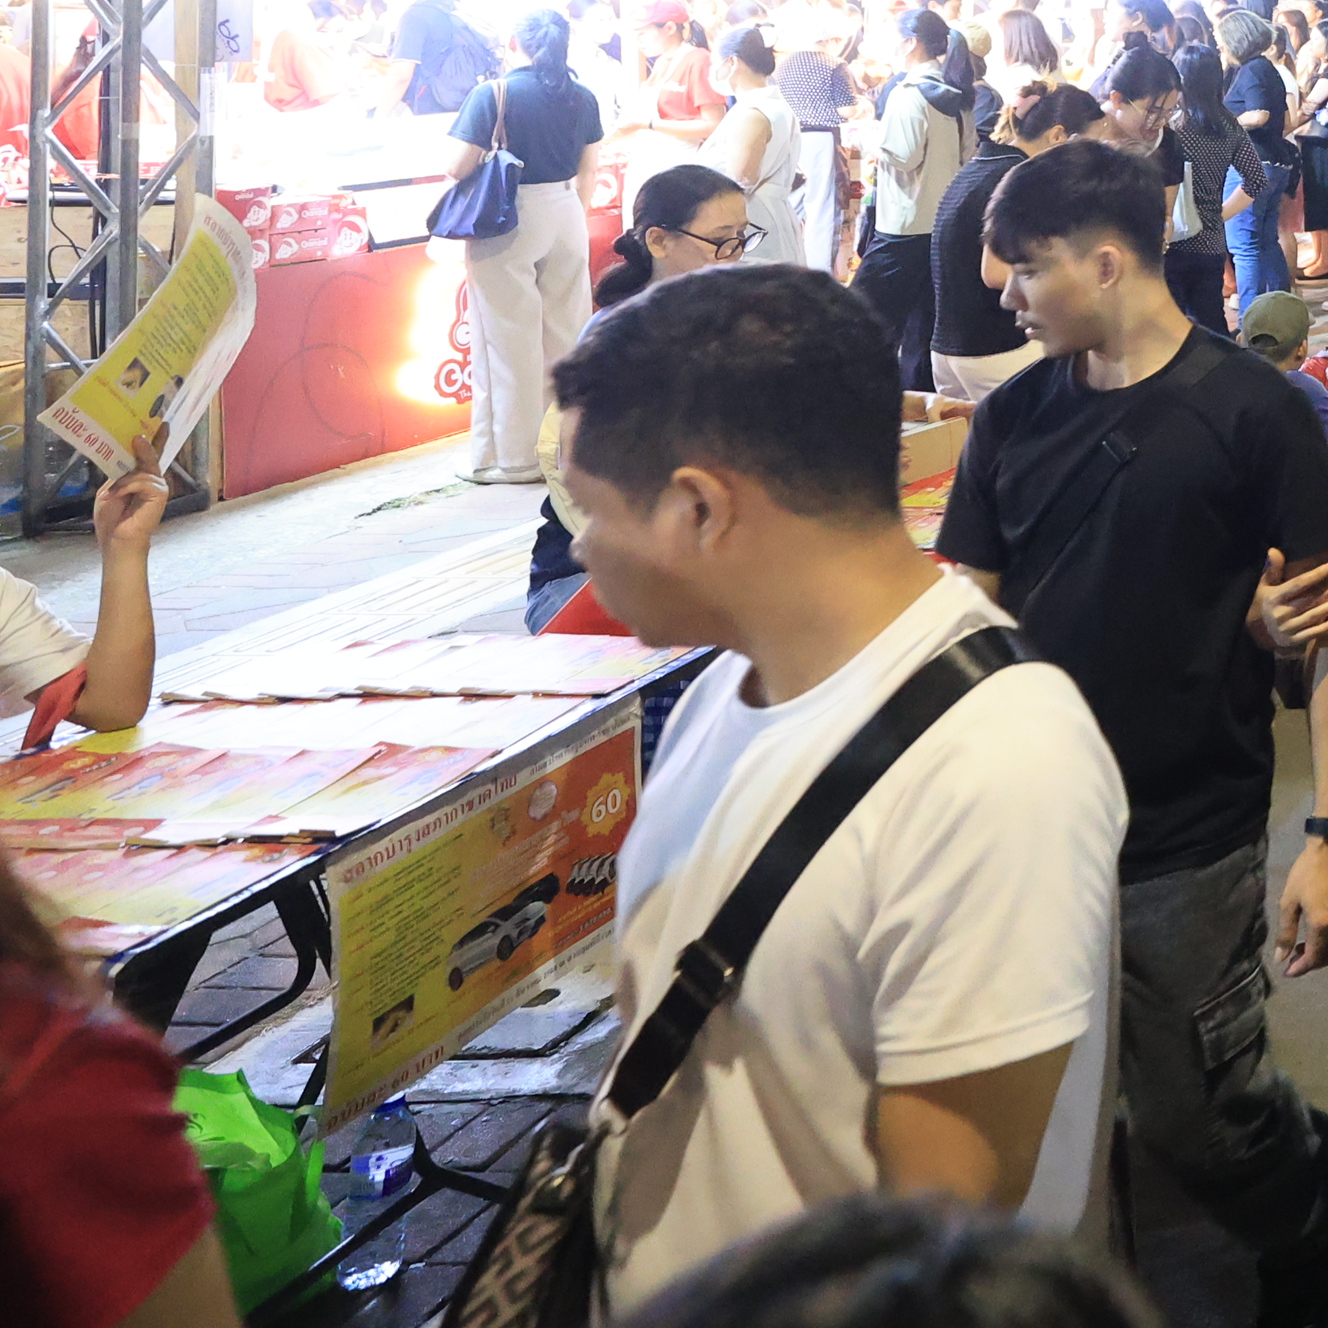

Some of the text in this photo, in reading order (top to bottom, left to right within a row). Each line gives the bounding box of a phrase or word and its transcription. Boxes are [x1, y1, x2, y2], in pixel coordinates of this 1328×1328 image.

[84, 433, 100, 447] 60
[95, 441, 115, 462] บาท
[590, 788, 622, 824] 60
[391, 1069, 410, 1090] 60
